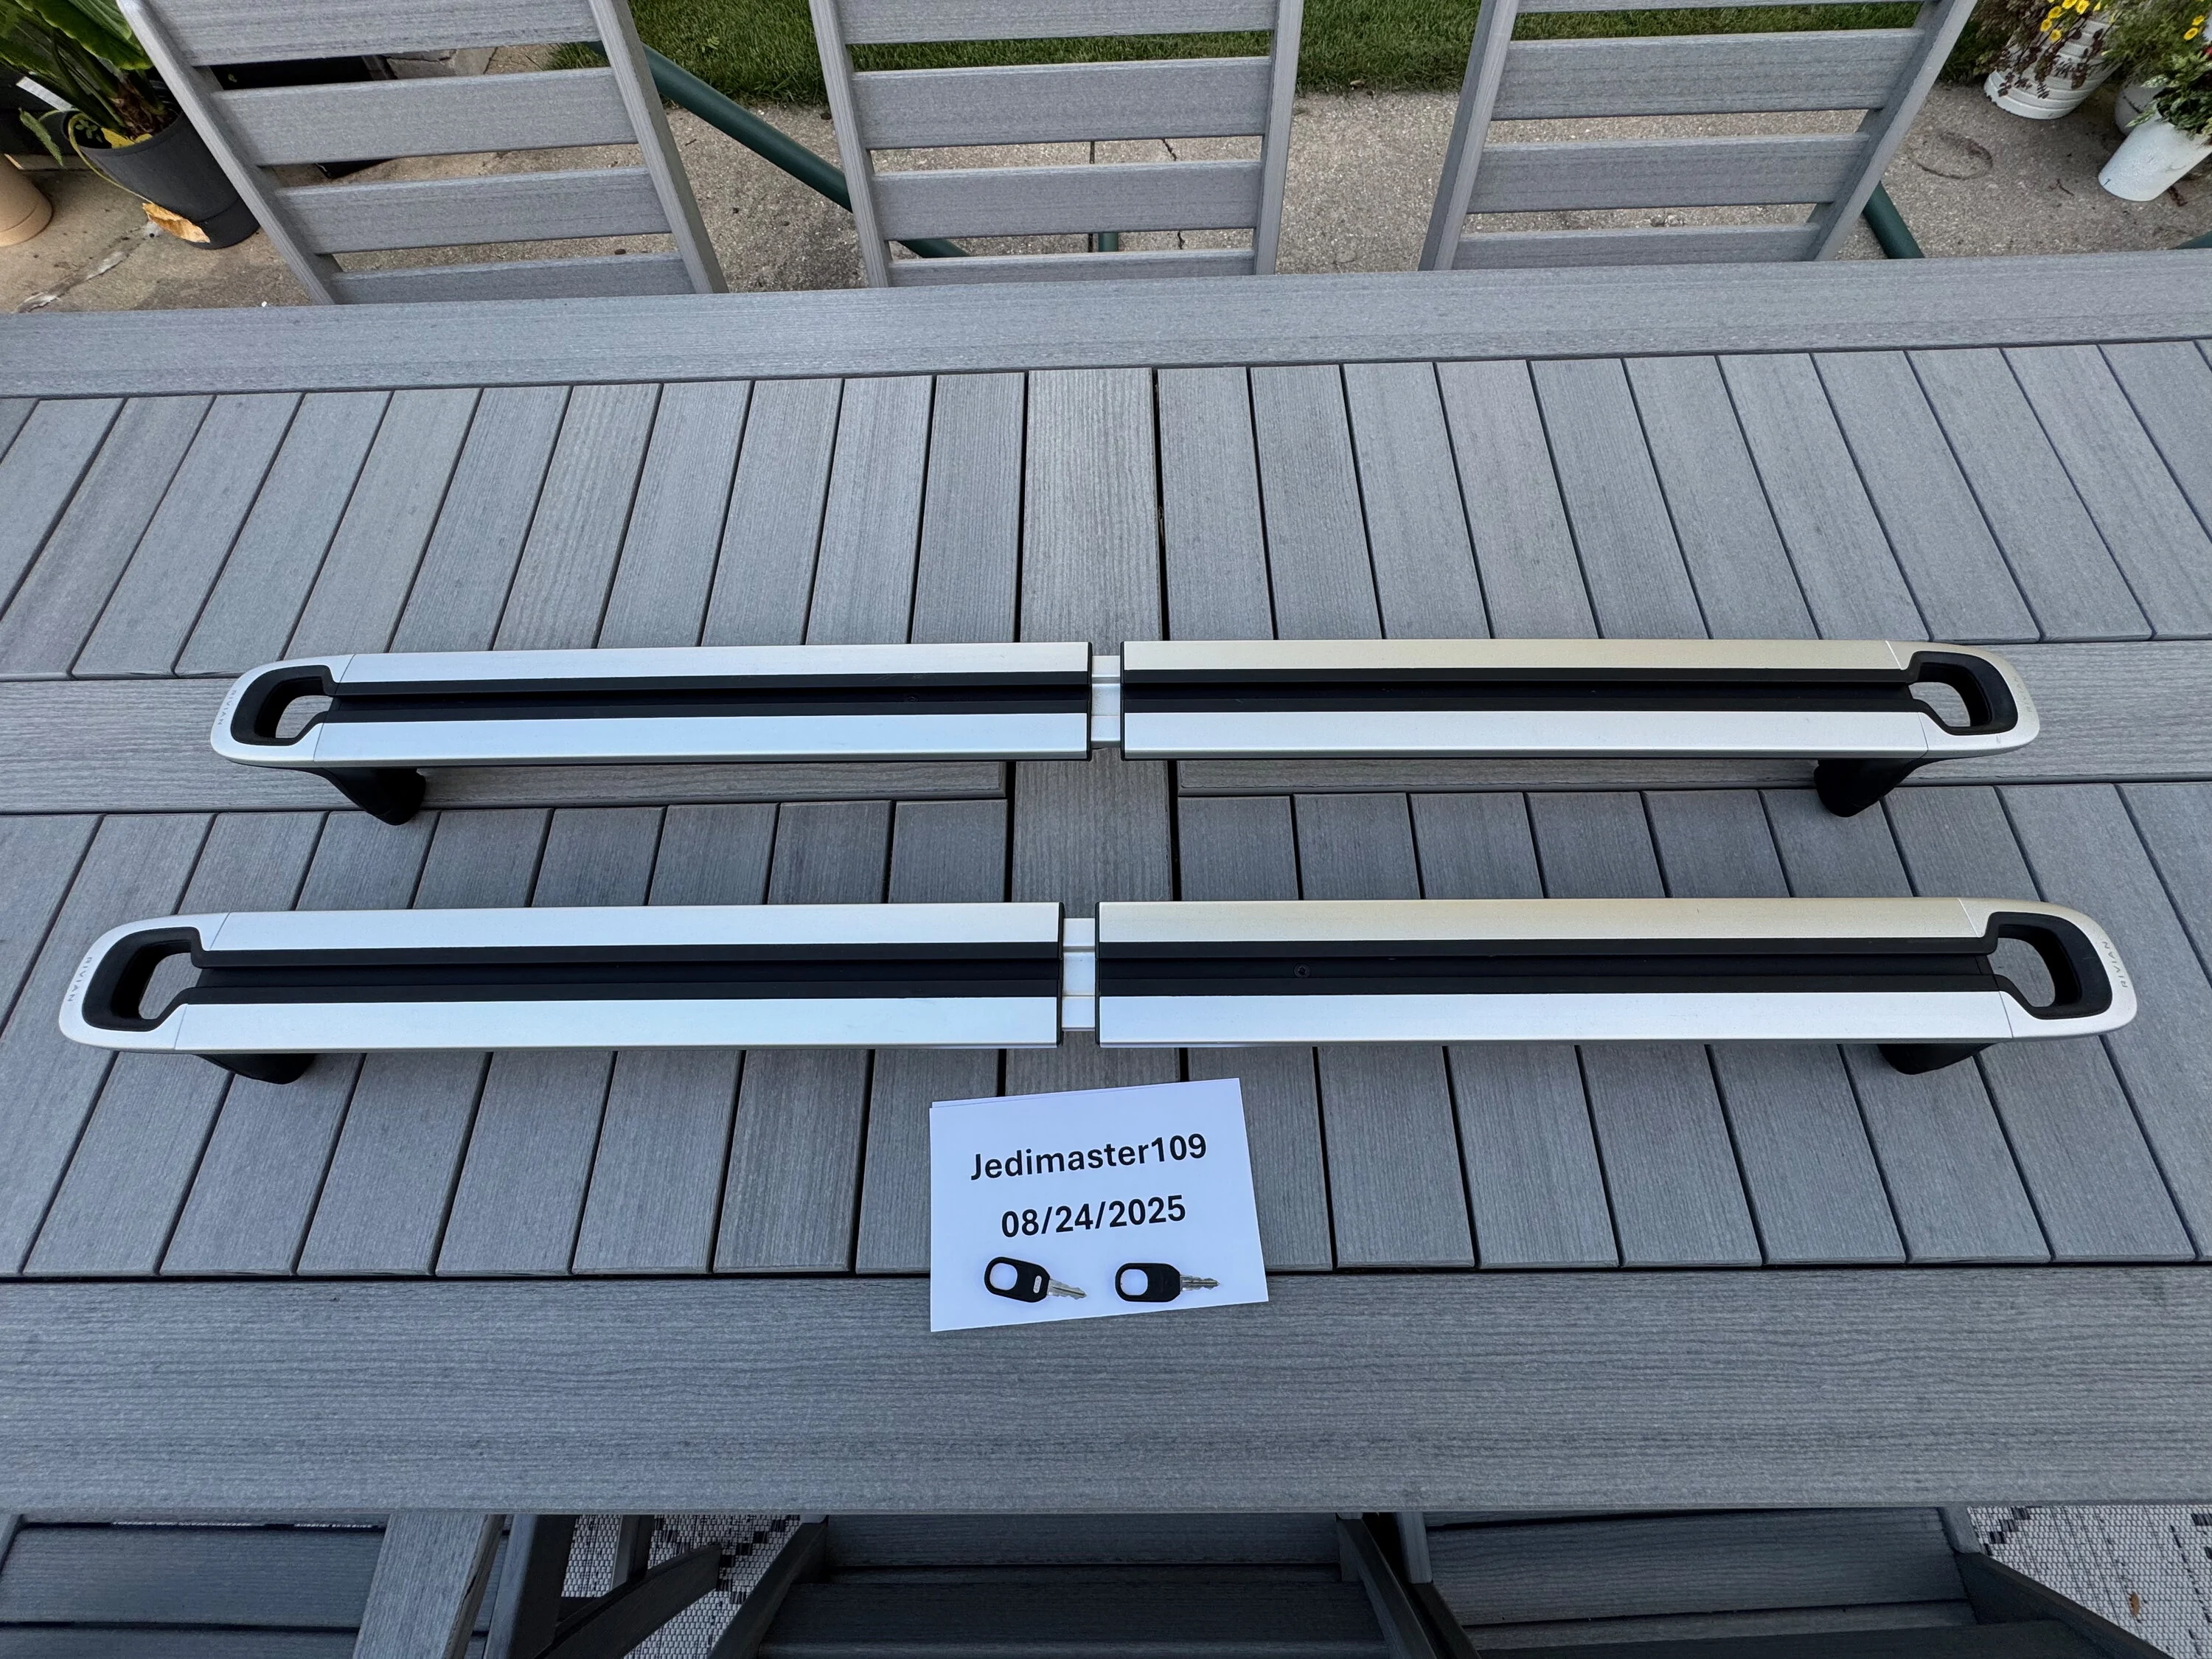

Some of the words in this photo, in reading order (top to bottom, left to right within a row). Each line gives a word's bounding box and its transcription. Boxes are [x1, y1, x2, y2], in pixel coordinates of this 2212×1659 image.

[67, 956, 92, 1002] RIVIAN
[2101, 941, 2129, 988] RIVIAN
[971, 1133, 1207, 1180] Jedimaster109
[1001, 1194, 1186, 1238] 08/24/2025
